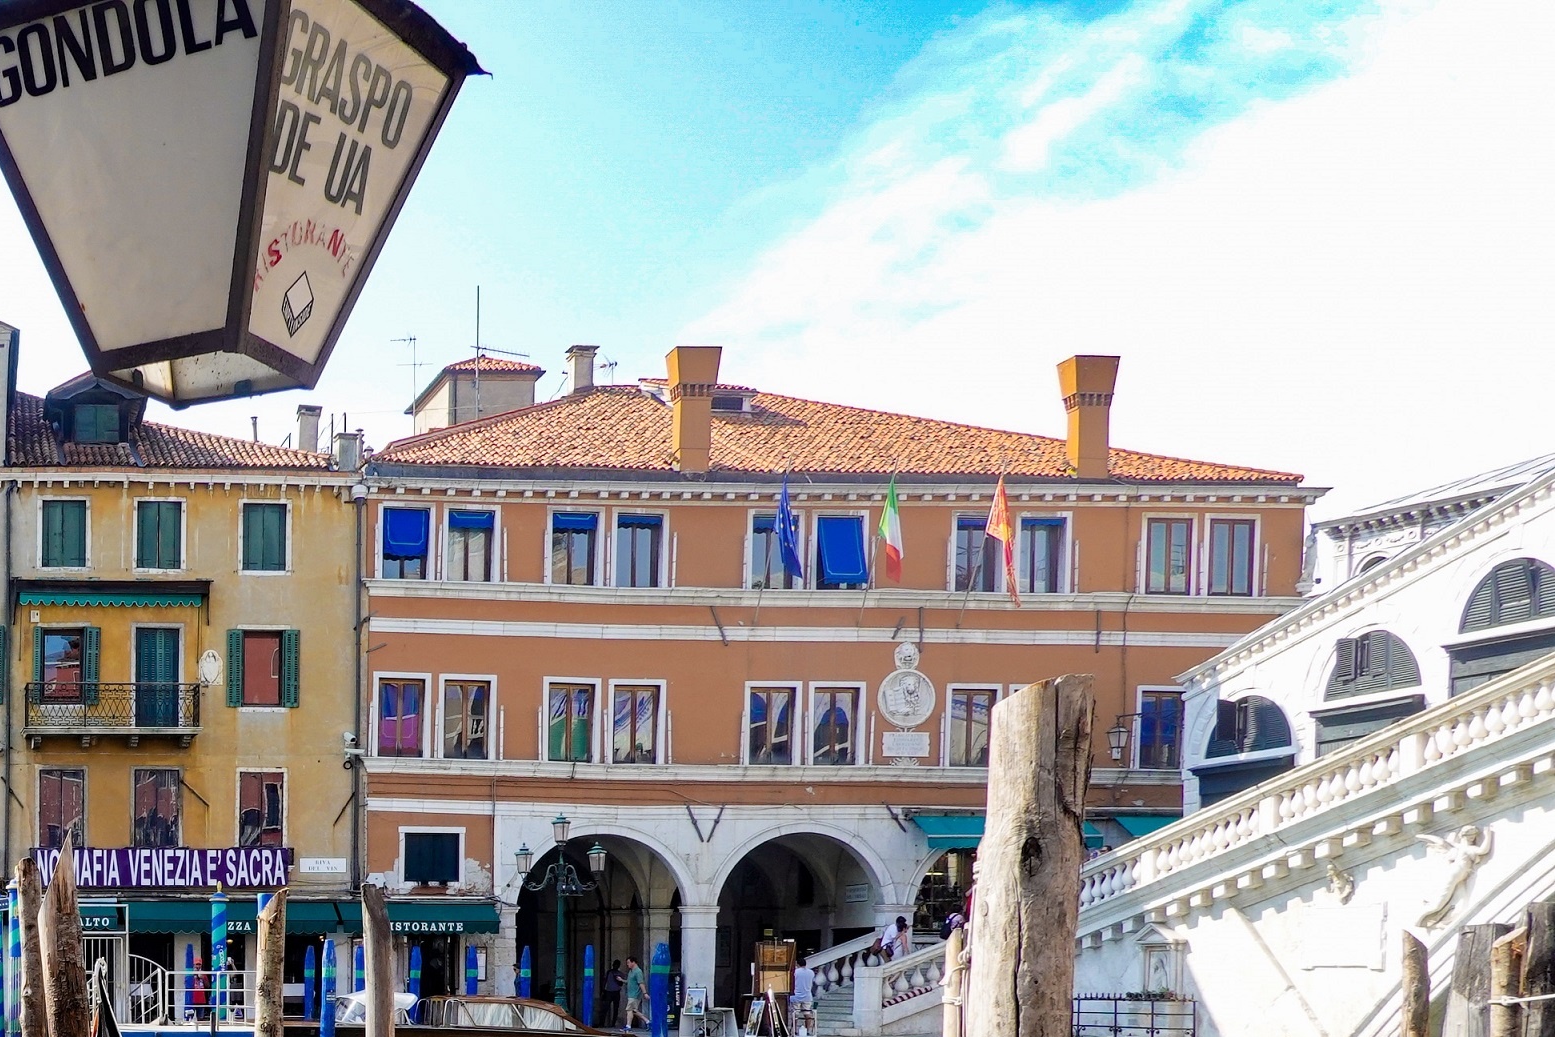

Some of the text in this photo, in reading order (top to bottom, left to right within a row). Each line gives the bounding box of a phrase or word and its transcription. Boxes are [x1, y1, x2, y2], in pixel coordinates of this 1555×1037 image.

[281, 8, 413, 150] GRASPO
[269, 99, 372, 216] DE UA
[128, 849, 203, 886] VENEZIA
[206, 849, 222, 886] E'
[225, 849, 287, 886] SACRA
[227, 921, 251, 931] ZZA
[390, 921, 464, 932] ISTORANTE
